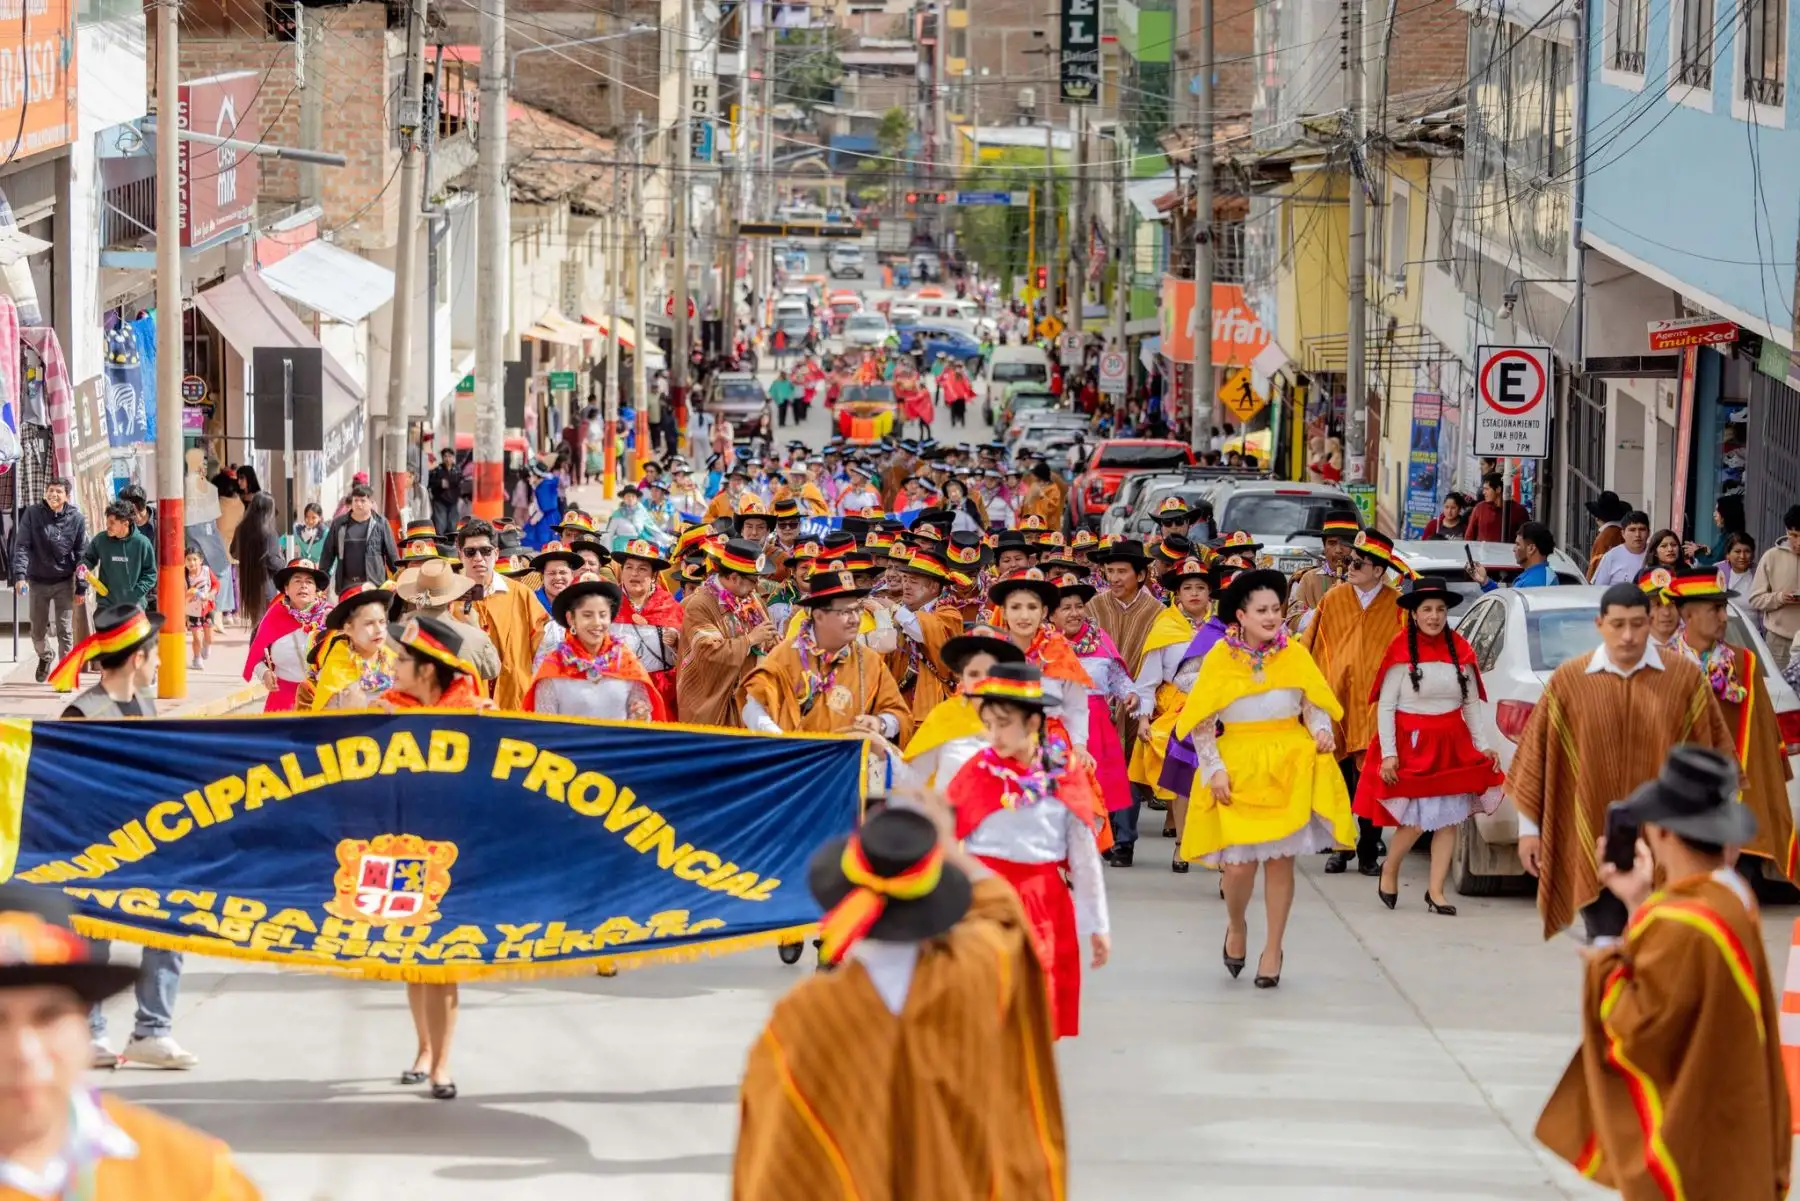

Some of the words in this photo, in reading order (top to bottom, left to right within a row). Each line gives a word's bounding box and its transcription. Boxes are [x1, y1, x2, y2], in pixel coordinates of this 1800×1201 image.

[1656, 330, 1689, 340] Agente
[1499, 363, 1526, 402] E
[1482, 419, 1539, 429] ESTACIONAMIENTO
[1493, 430, 1507, 440] UNA
[1509, 431, 1527, 441] HORA
[1490, 443, 1504, 452] 9AM
[1516, 443, 1530, 452] 7PM
[14, 729, 469, 884] MUNICIPALIDAD
[491, 738, 782, 901] PROVINCIAL
